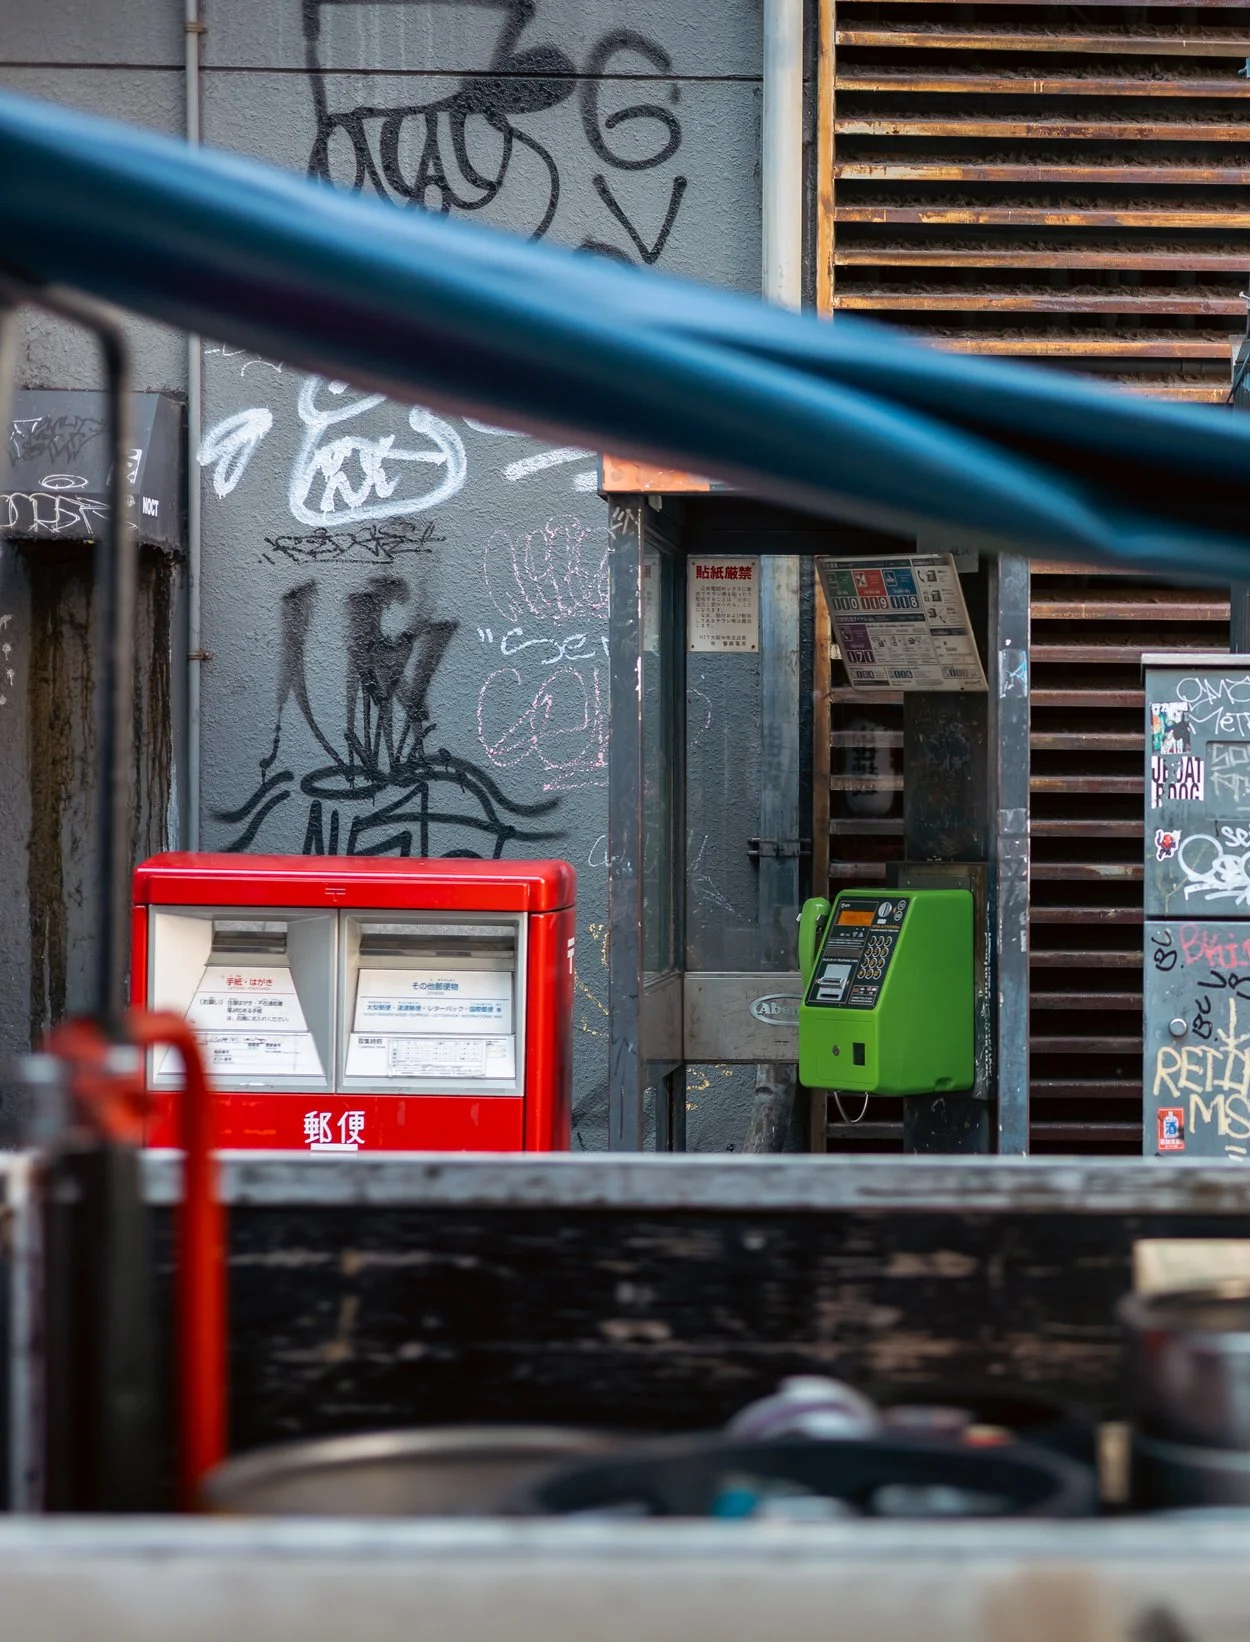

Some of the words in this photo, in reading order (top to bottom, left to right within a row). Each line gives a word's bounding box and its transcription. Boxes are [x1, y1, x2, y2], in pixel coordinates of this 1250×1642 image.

[696, 565, 752, 580] 貼紙厳禁
[834, 598, 860, 610] 110
[863, 597, 889, 609] 119
[892, 596, 919, 608] 118
[850, 651, 873, 662] 171
[226, 977, 273, 987] 手紙・はがき
[411, 982, 459, 991] その他郵便物
[303, 1110, 366, 1144] 郵便
